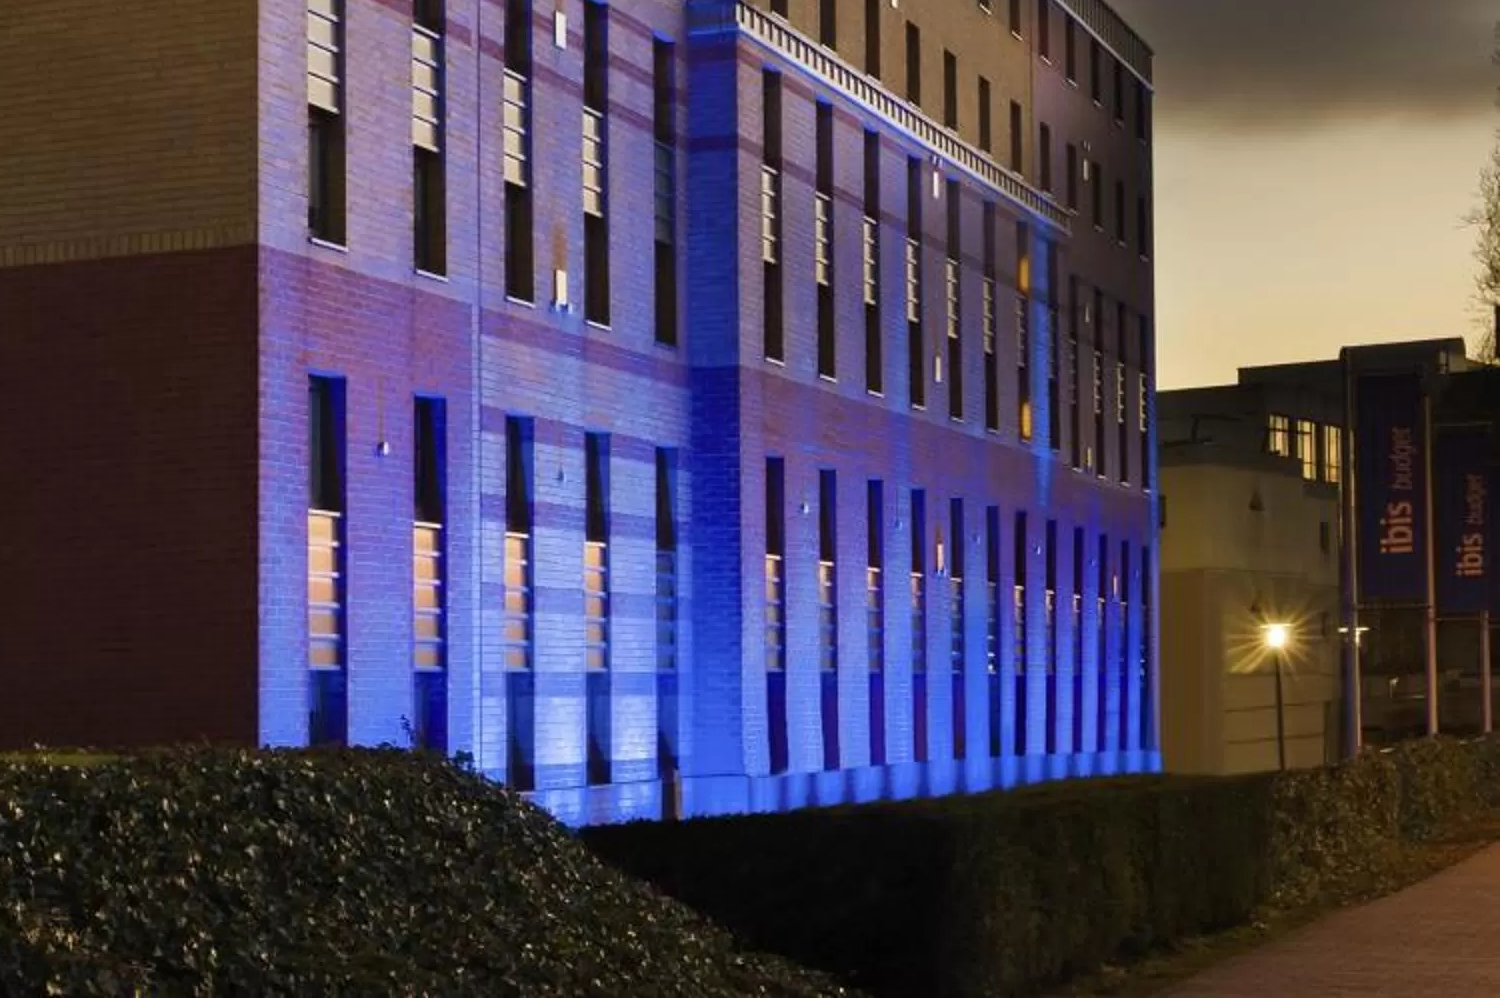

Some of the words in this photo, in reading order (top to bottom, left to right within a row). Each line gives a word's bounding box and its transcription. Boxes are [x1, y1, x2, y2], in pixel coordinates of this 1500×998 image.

[1389, 426, 1416, 490] budget
[1380, 501, 1413, 554] ibis
[1456, 532, 1484, 577] ibis
